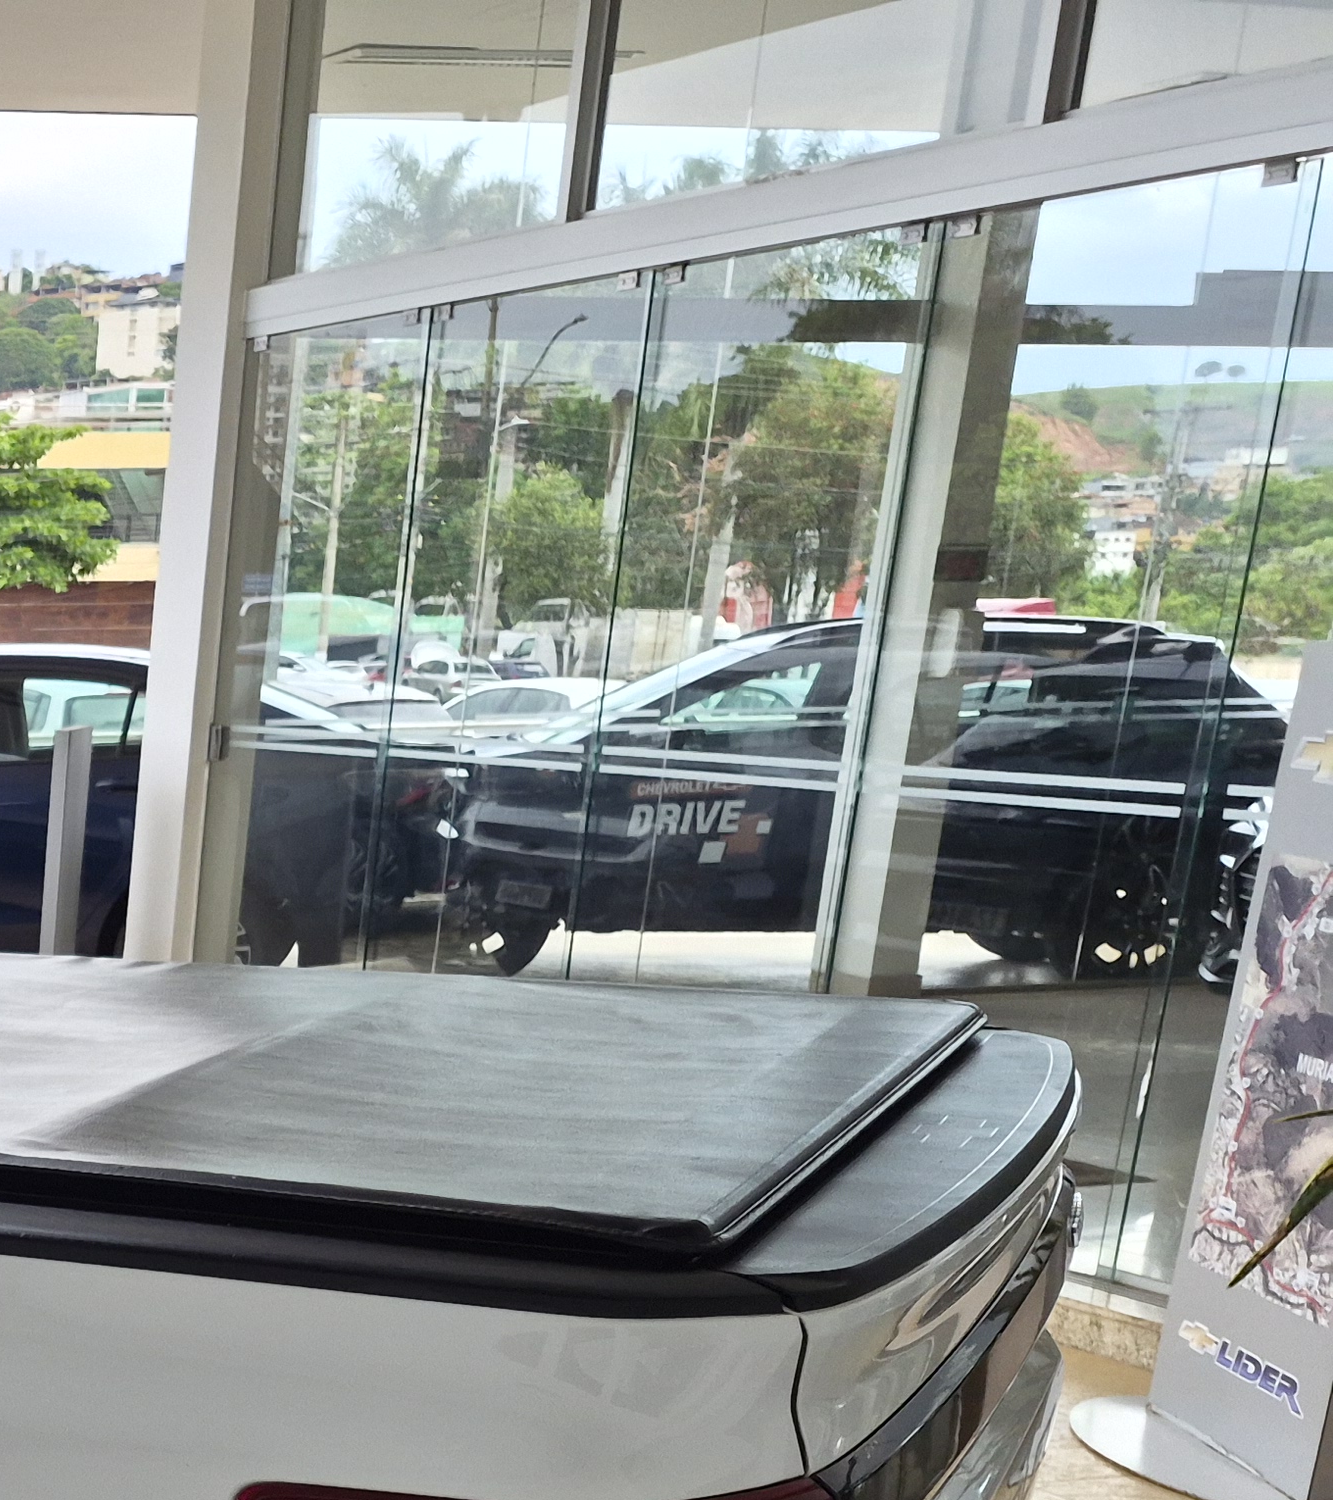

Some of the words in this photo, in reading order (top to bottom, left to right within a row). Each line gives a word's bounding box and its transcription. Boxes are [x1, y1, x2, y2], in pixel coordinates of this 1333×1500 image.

[637, 780, 712, 796] CHEVROLET
[627, 800, 746, 838] DRIVE
[1214, 1338, 1302, 1417] LIDER
